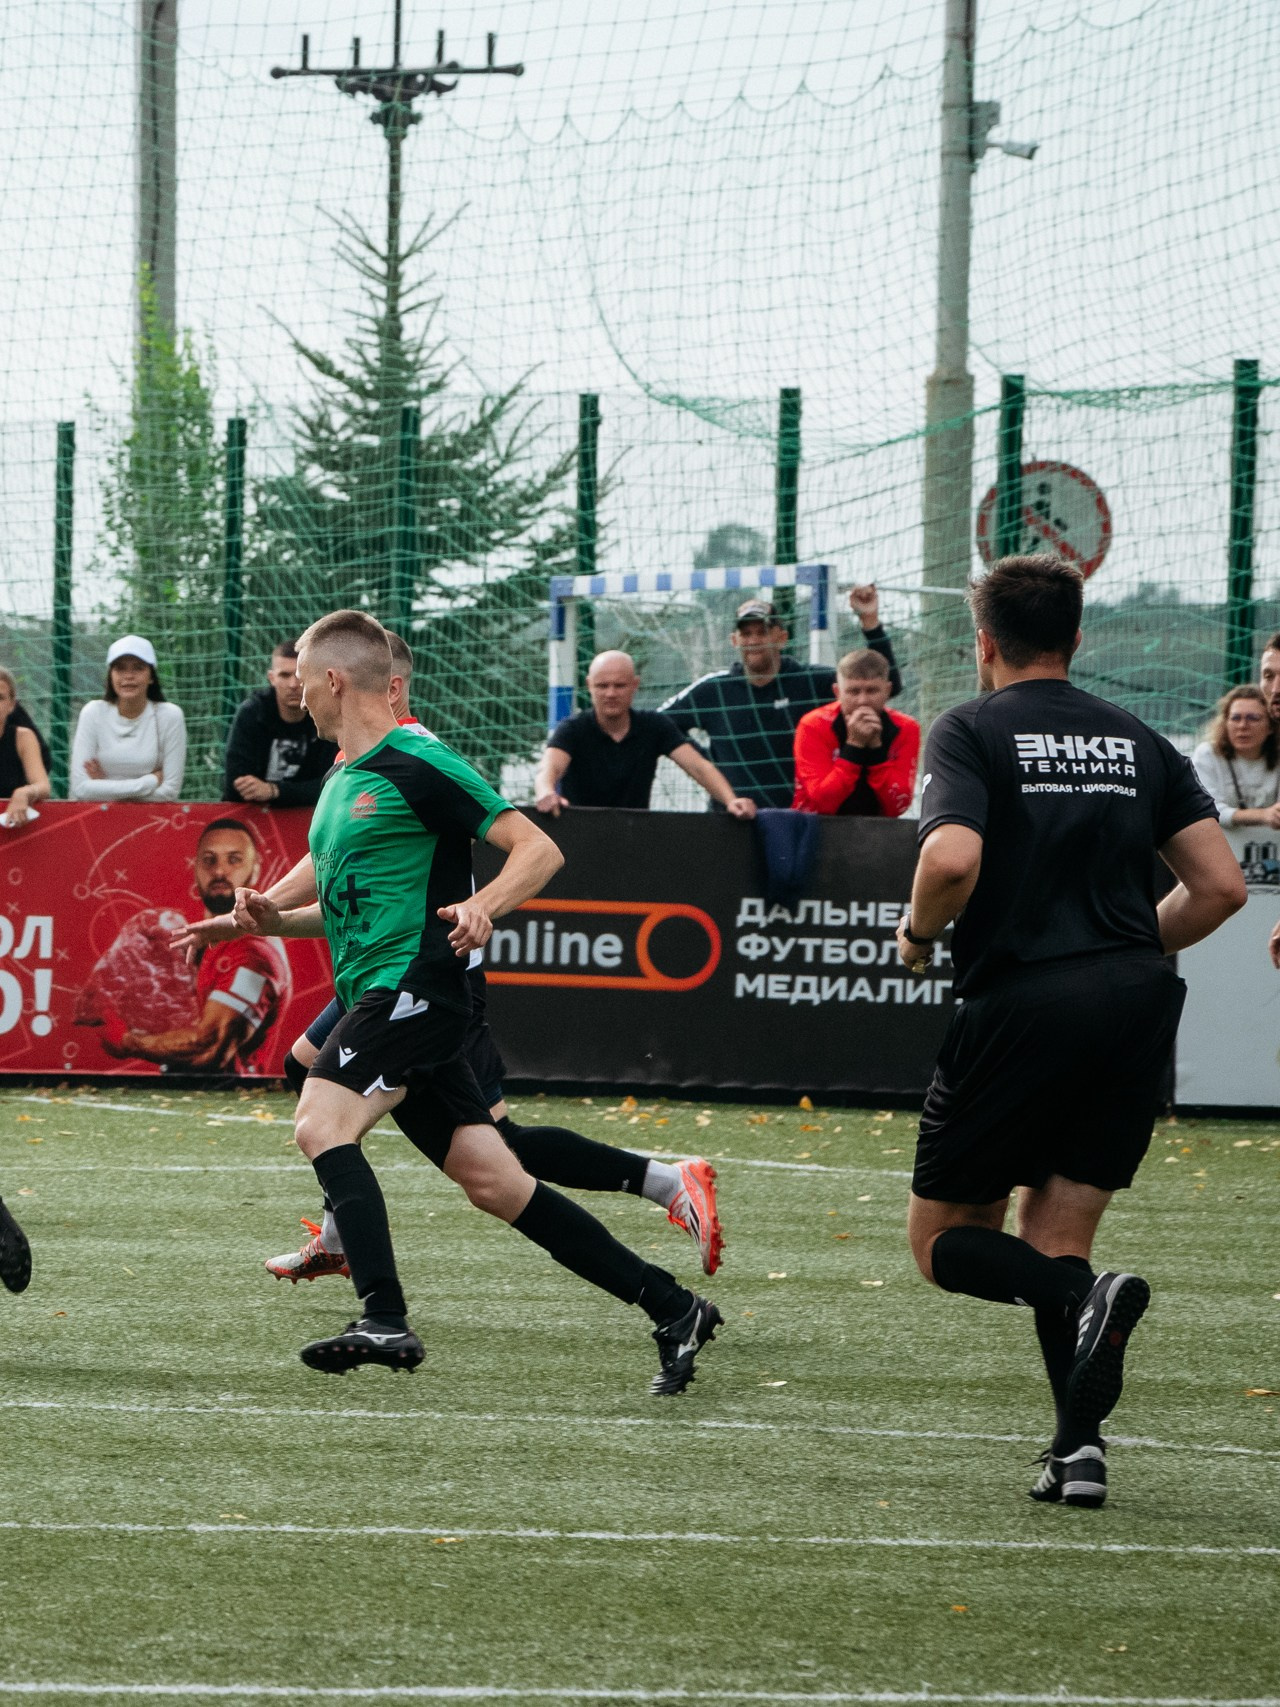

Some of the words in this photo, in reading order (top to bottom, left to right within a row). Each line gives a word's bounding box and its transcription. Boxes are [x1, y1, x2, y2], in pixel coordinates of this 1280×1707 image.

[1014, 734, 1135, 763] ЭНКА
[1019, 760, 1137, 778] ТЕХНИКА
[1021, 783, 1073, 794] БЫТОВАЯ
[1082, 783, 1137, 798] ЦИФРОВАЯ
[736, 898, 912, 929] ДАЛЬНЕ
[489, 920, 624, 968] nline
[735, 973, 963, 1006] МЕДИАЛИГ
